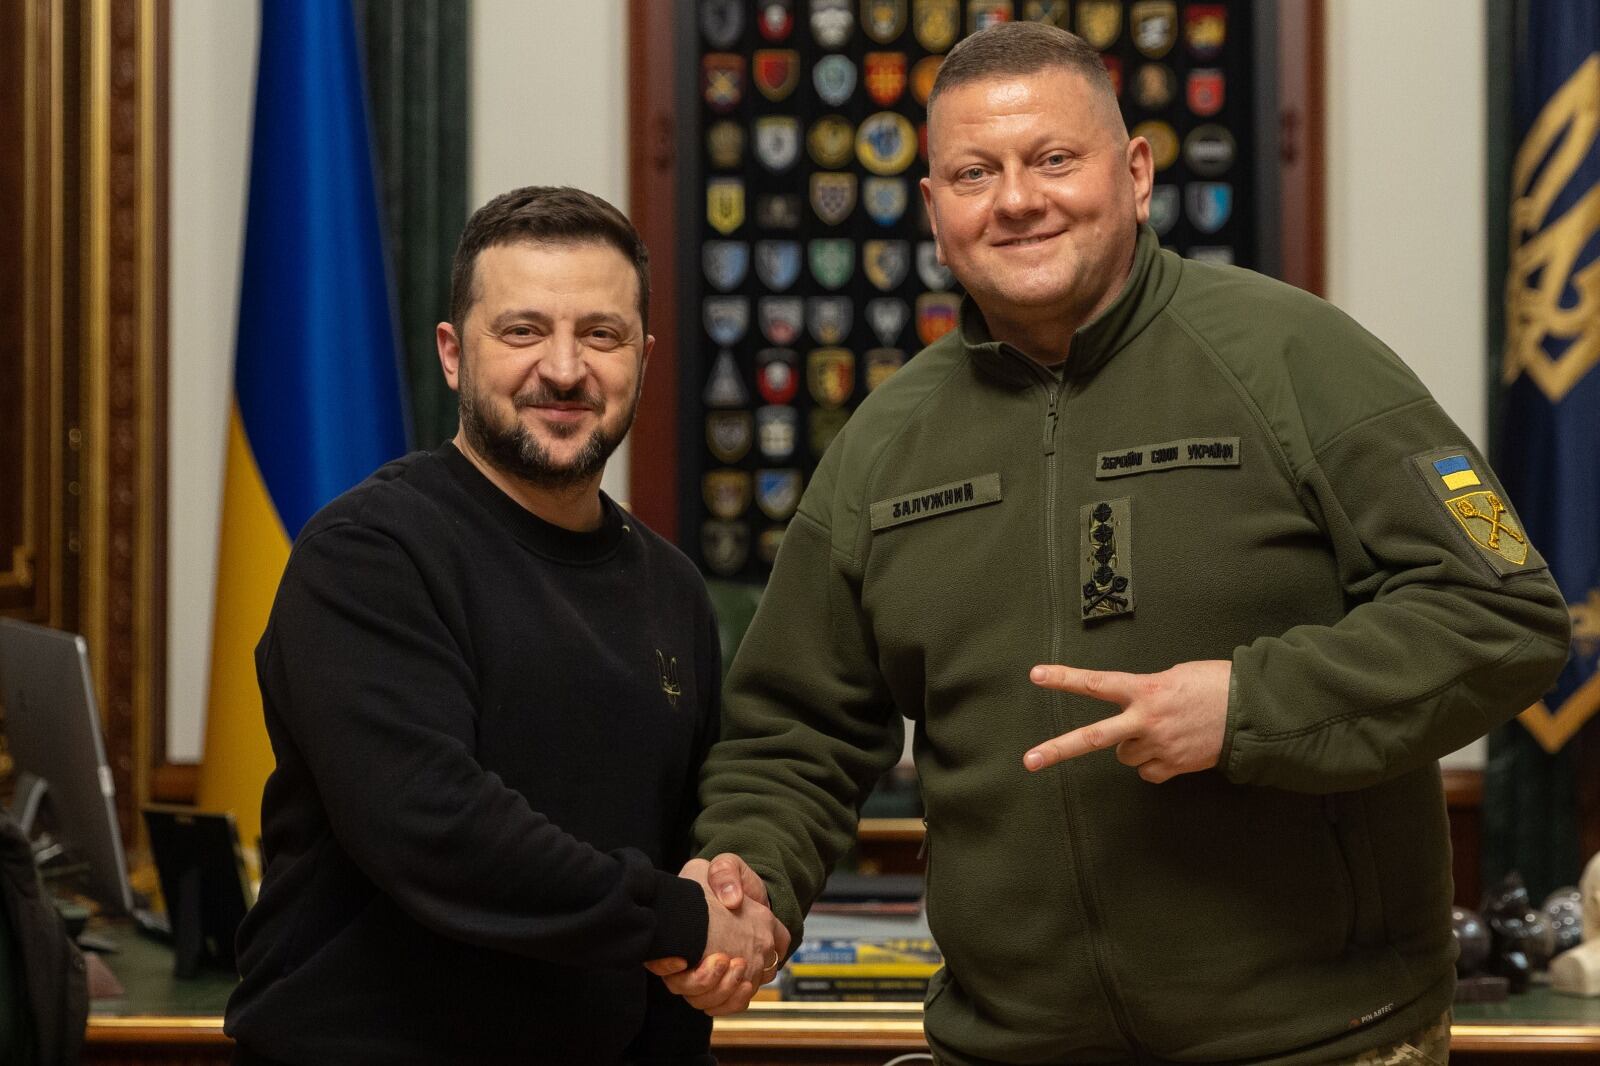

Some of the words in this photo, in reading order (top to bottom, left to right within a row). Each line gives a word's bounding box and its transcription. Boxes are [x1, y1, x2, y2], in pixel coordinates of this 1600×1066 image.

[1151, 446, 1179, 463] СИЛИ
[1187, 442, 1234, 460] УКРАЇНИ
[892, 482, 974, 518] ЗАЛУЖНИЙ
